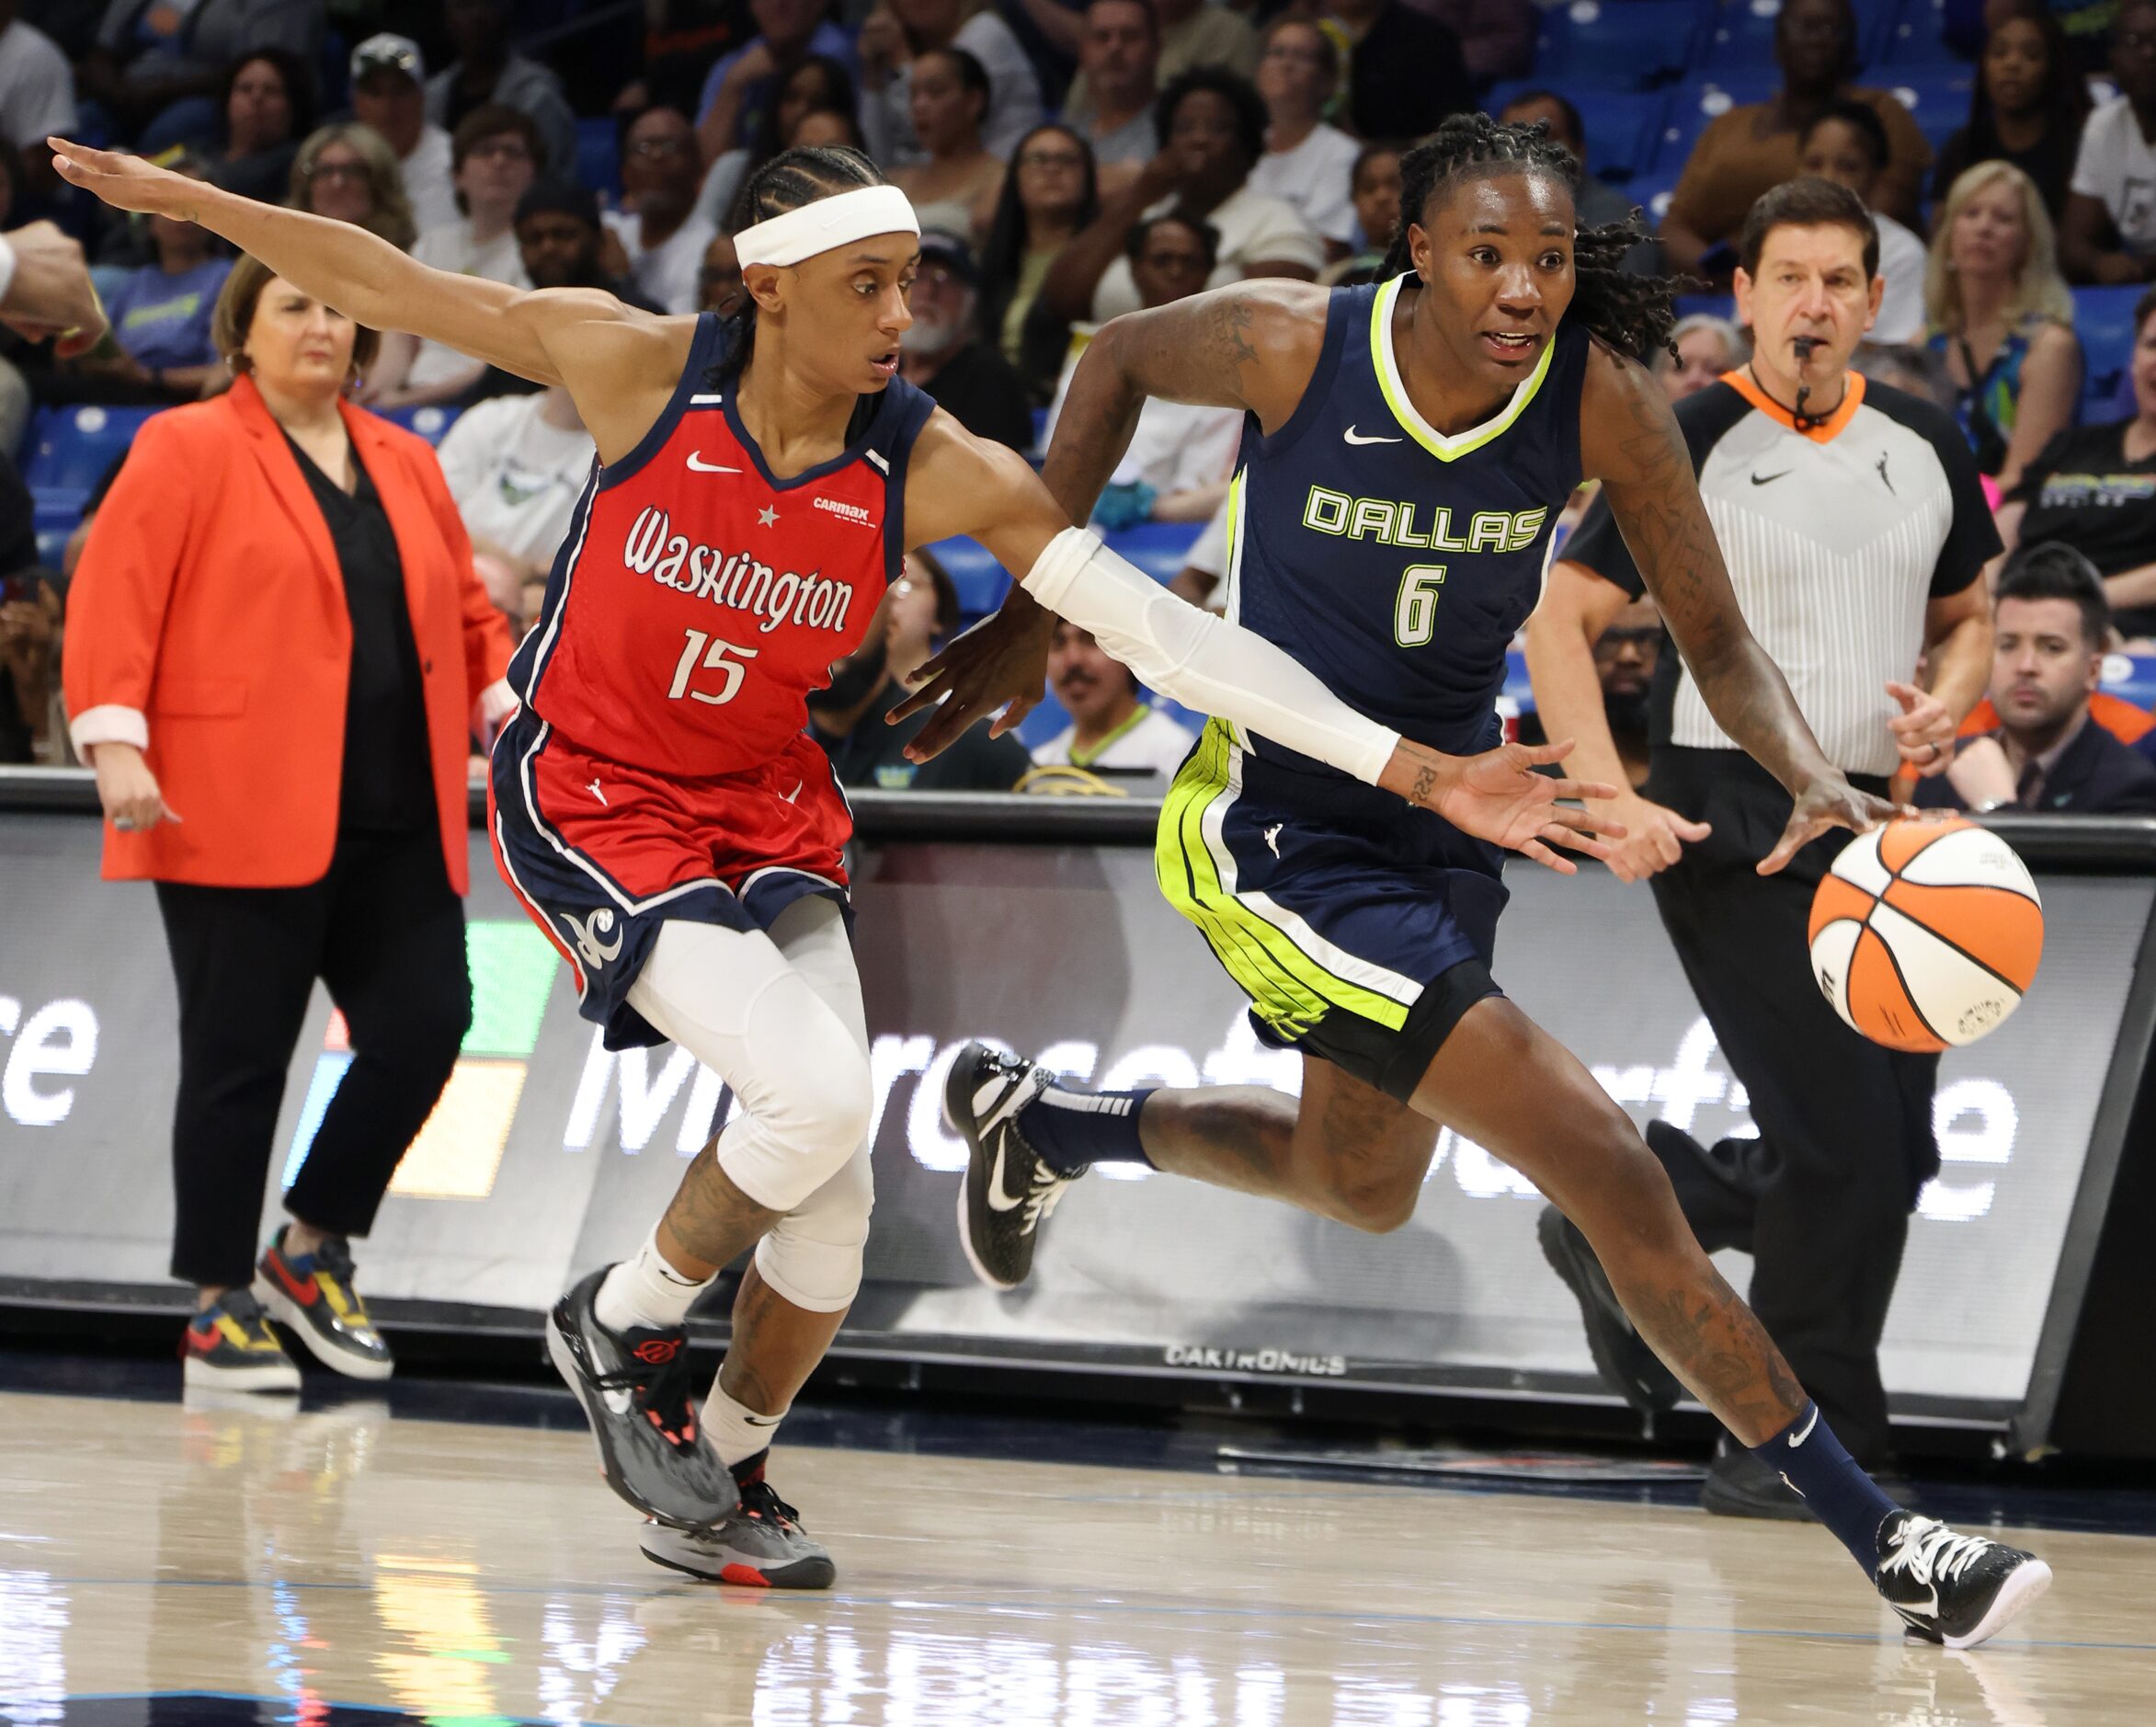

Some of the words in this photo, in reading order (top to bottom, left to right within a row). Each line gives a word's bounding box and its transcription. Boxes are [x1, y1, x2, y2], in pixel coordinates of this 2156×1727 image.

[1302, 484, 1548, 553] DALLAS
[623, 504, 853, 634] Washington
[1394, 564, 1447, 647] 6
[667, 627, 759, 705] 15
